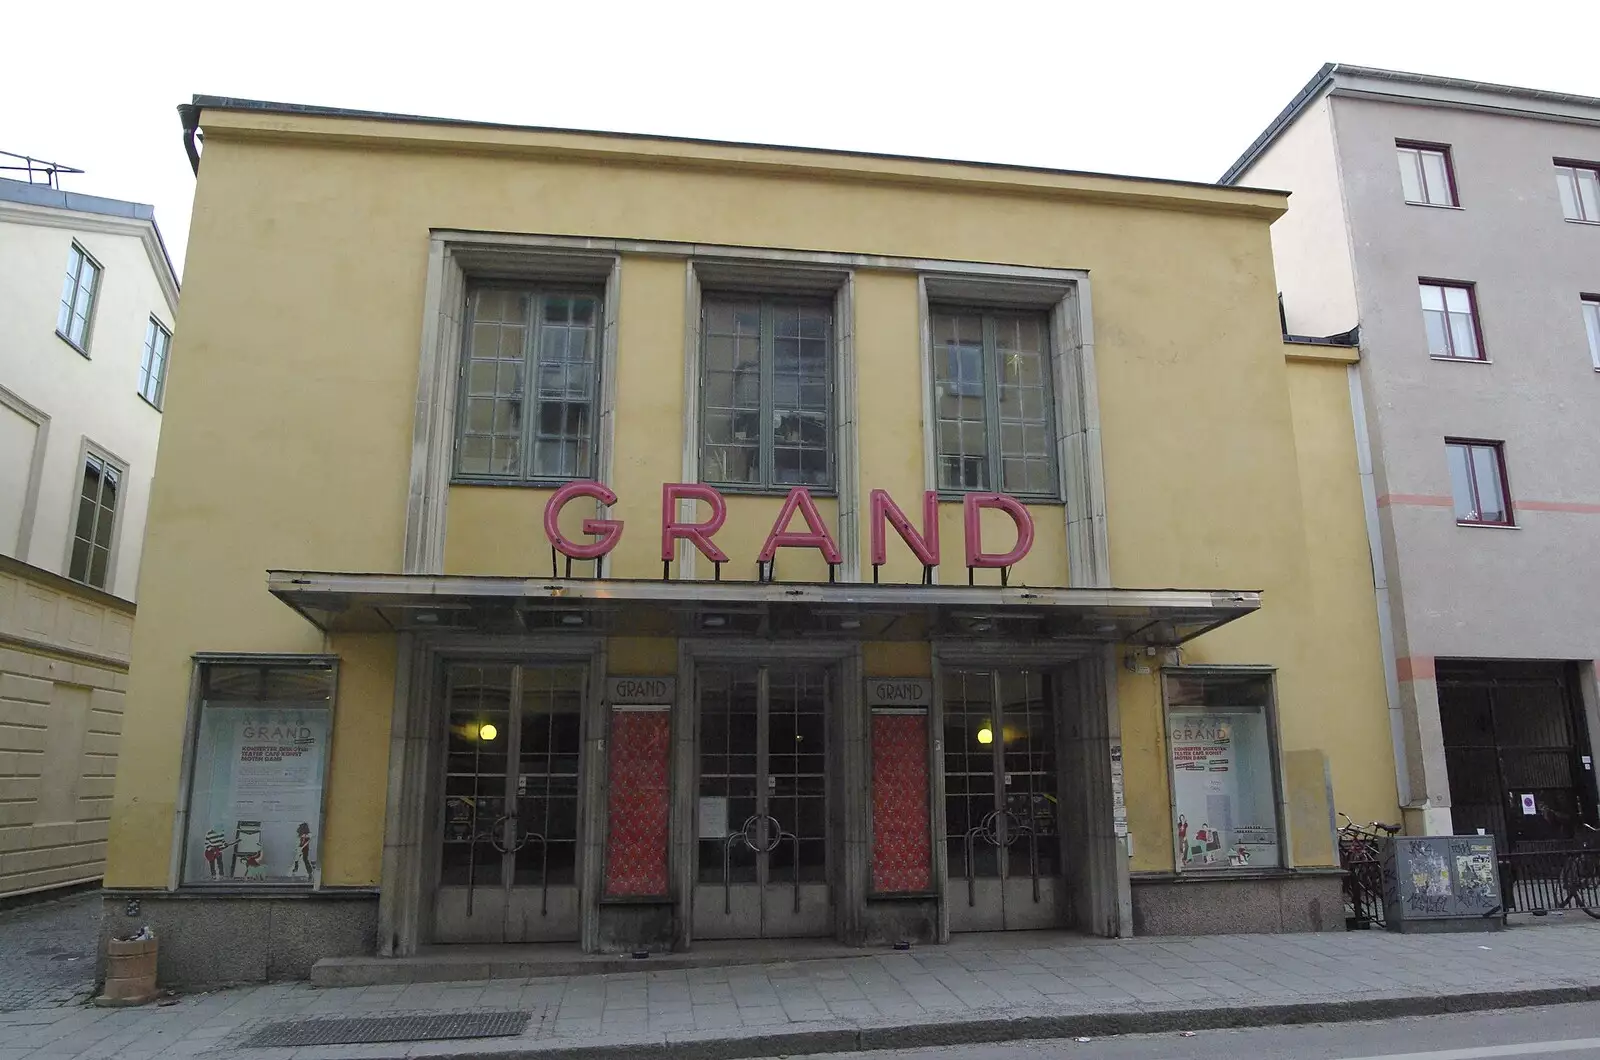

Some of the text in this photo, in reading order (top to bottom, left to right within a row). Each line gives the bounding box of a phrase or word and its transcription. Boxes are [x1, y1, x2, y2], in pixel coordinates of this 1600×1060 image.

[544, 480, 1036, 569] GRAND
[616, 680, 667, 698] GRAND
[876, 683, 923, 700] GRAND
[243, 726, 311, 739] GRAND
[1173, 729, 1226, 740] GRAND
